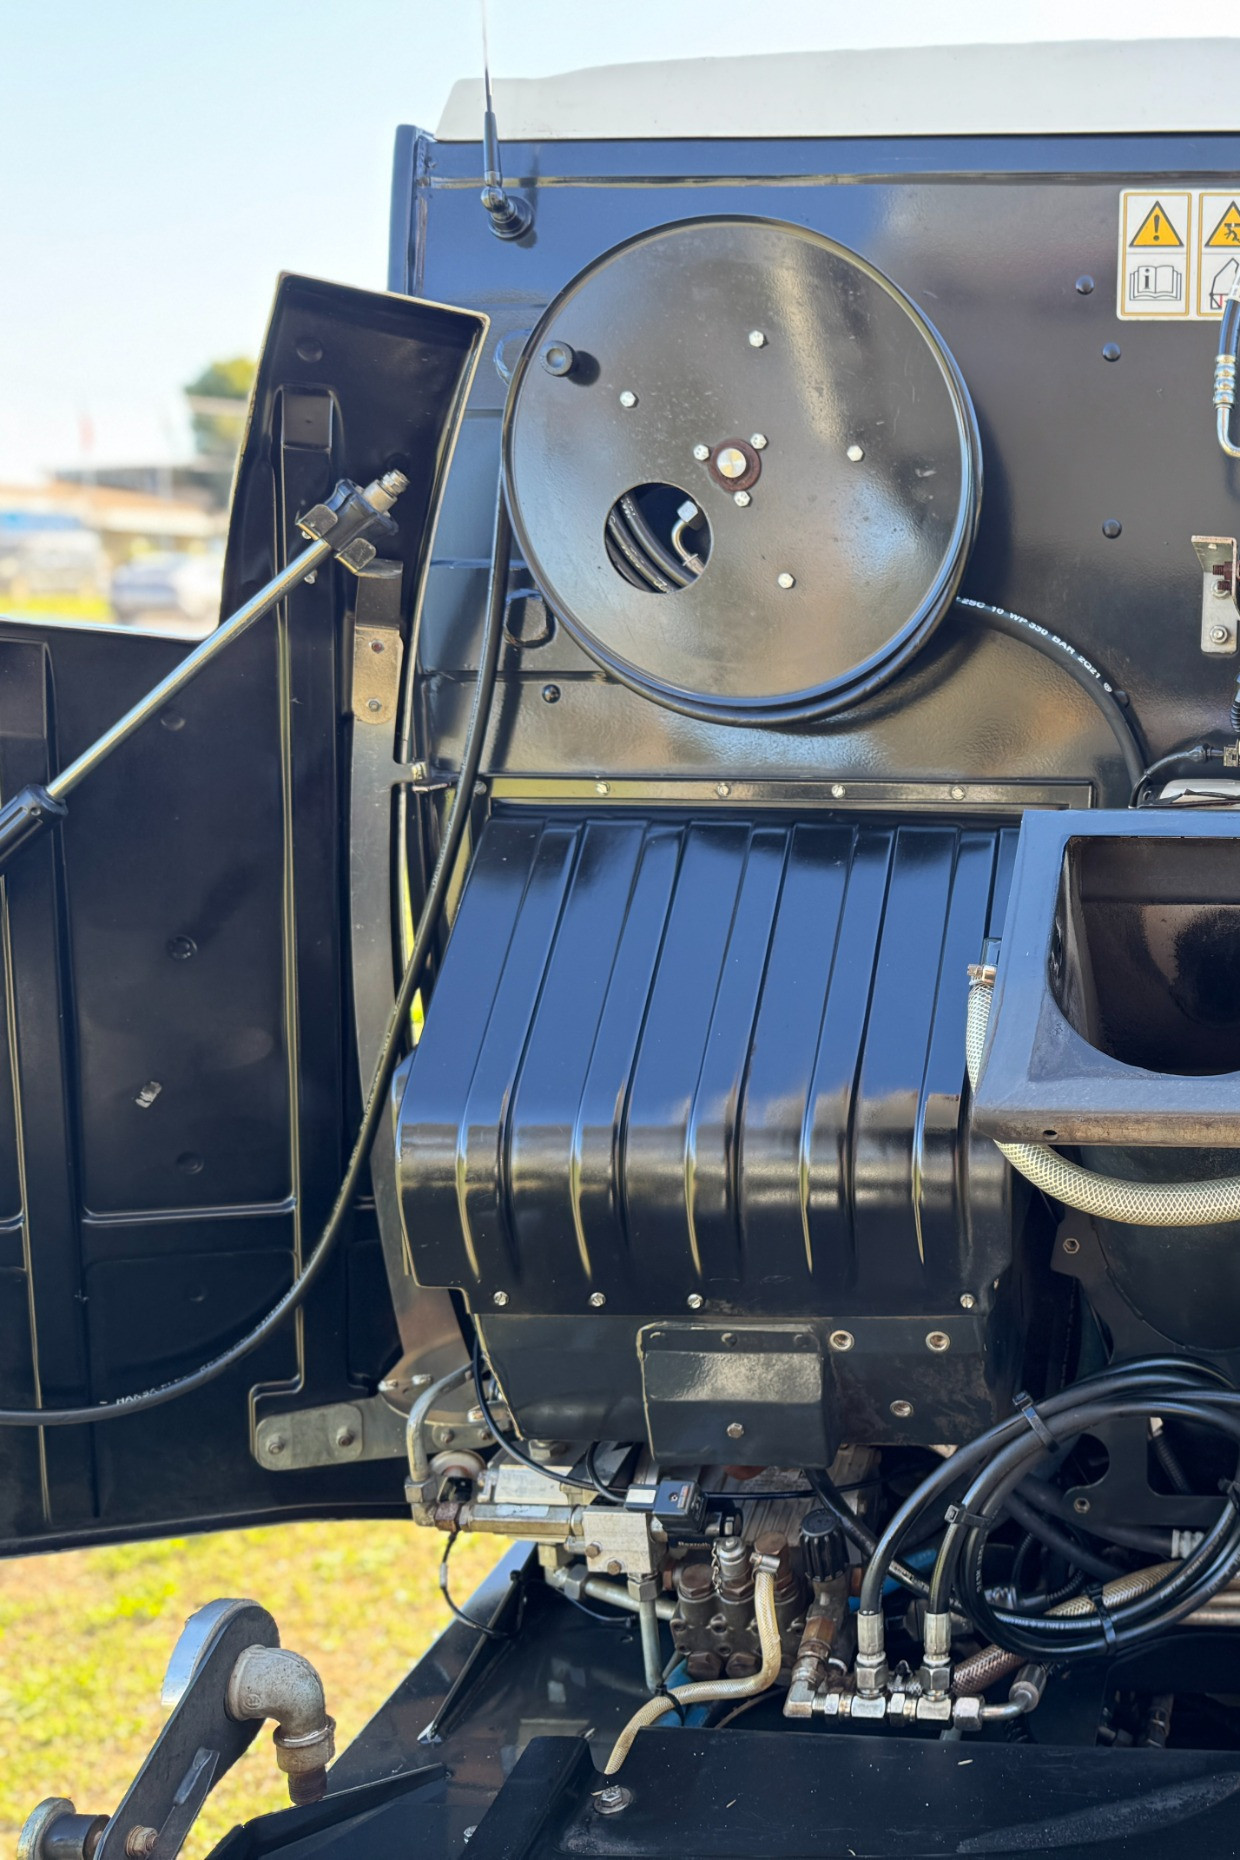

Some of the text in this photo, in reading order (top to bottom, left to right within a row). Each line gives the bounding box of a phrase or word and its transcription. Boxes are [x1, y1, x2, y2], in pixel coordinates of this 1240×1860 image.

[992, 605, 1005, 615] 10
[1009, 612, 1028, 623] WP
[1028, 622, 1049, 636] 330
[1051, 635, 1075, 655] BAR
[1078, 655, 1101, 679] 2Q21
